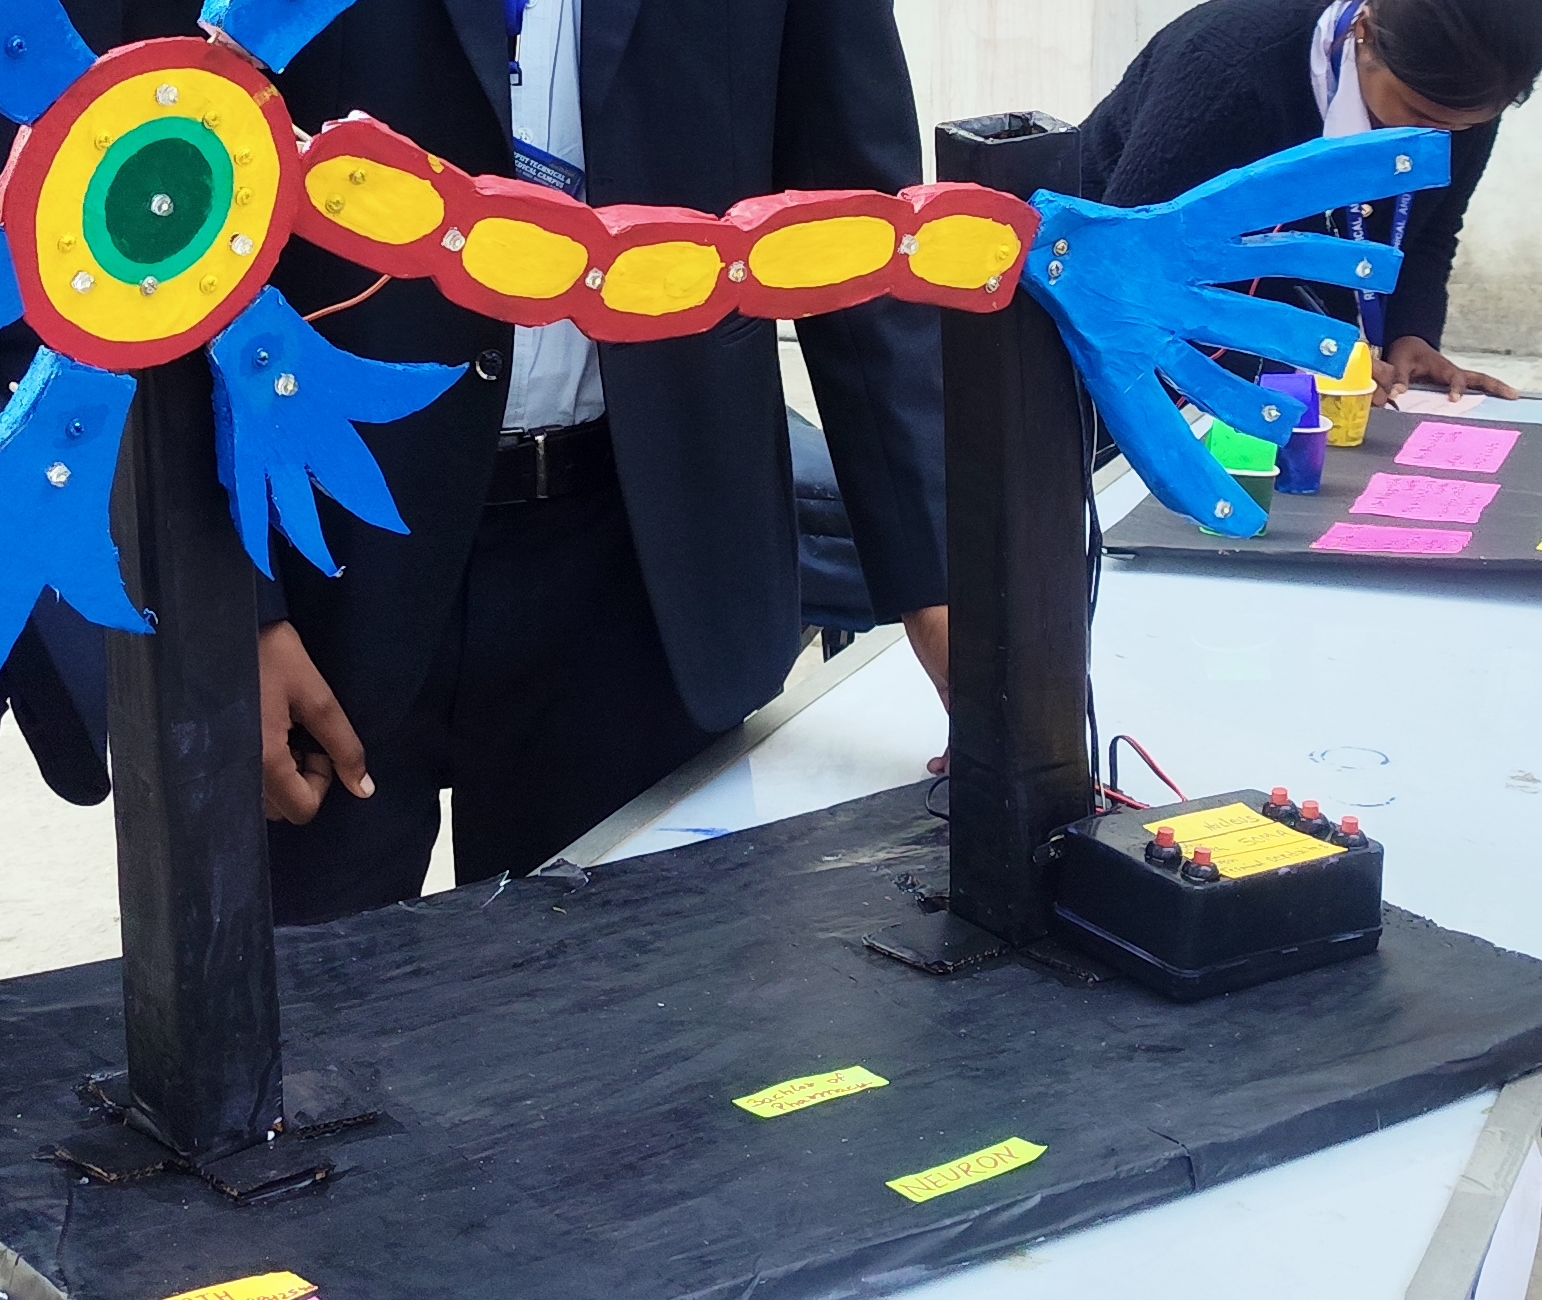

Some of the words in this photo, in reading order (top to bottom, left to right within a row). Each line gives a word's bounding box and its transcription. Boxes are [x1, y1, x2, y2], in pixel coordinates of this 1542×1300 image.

[537, 171, 565, 189] CAMPUS
[1238, 828, 1294, 847] SOMA
[826, 1072, 846, 1084] of
[899, 1145, 1021, 1198] NEURON
